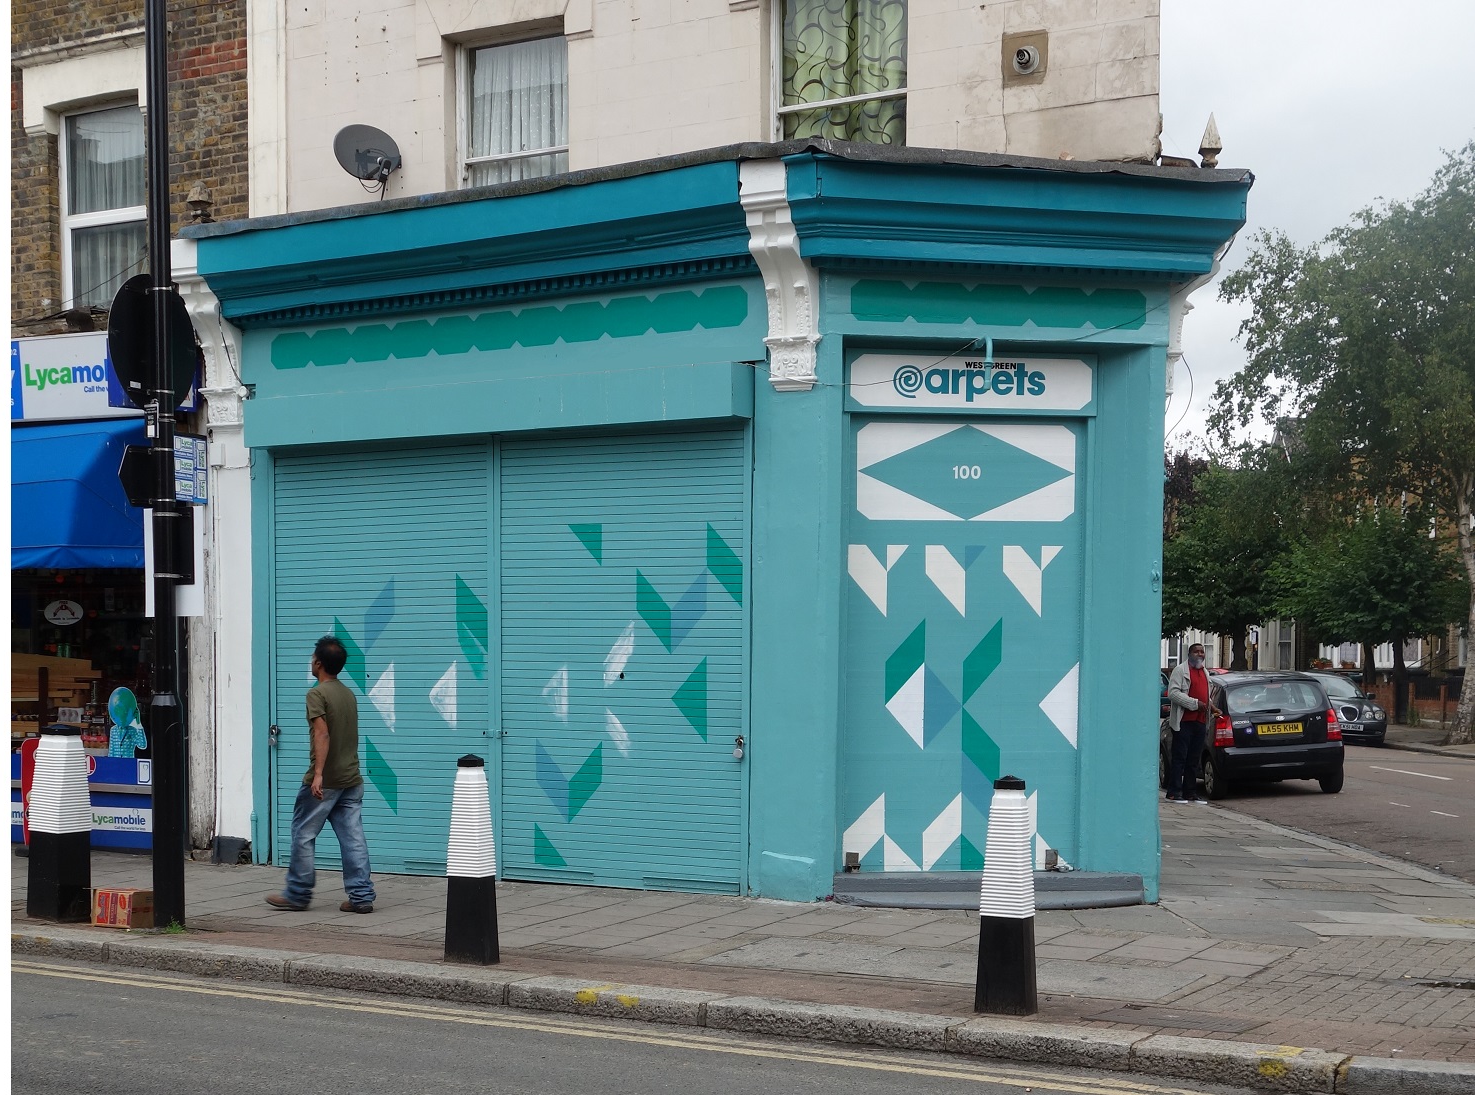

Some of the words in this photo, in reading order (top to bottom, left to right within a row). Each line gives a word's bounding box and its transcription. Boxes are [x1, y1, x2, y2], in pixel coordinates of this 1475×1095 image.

[965, 361, 986, 369] WES
[991, 362, 1016, 370] REEN
[24, 359, 108, 390] Lycamo
[952, 465, 981, 480] 100
[1261, 725, 1282, 734] LA55
[1284, 723, 1300, 732] KHM
[92, 812, 146, 826] Lycamobile
